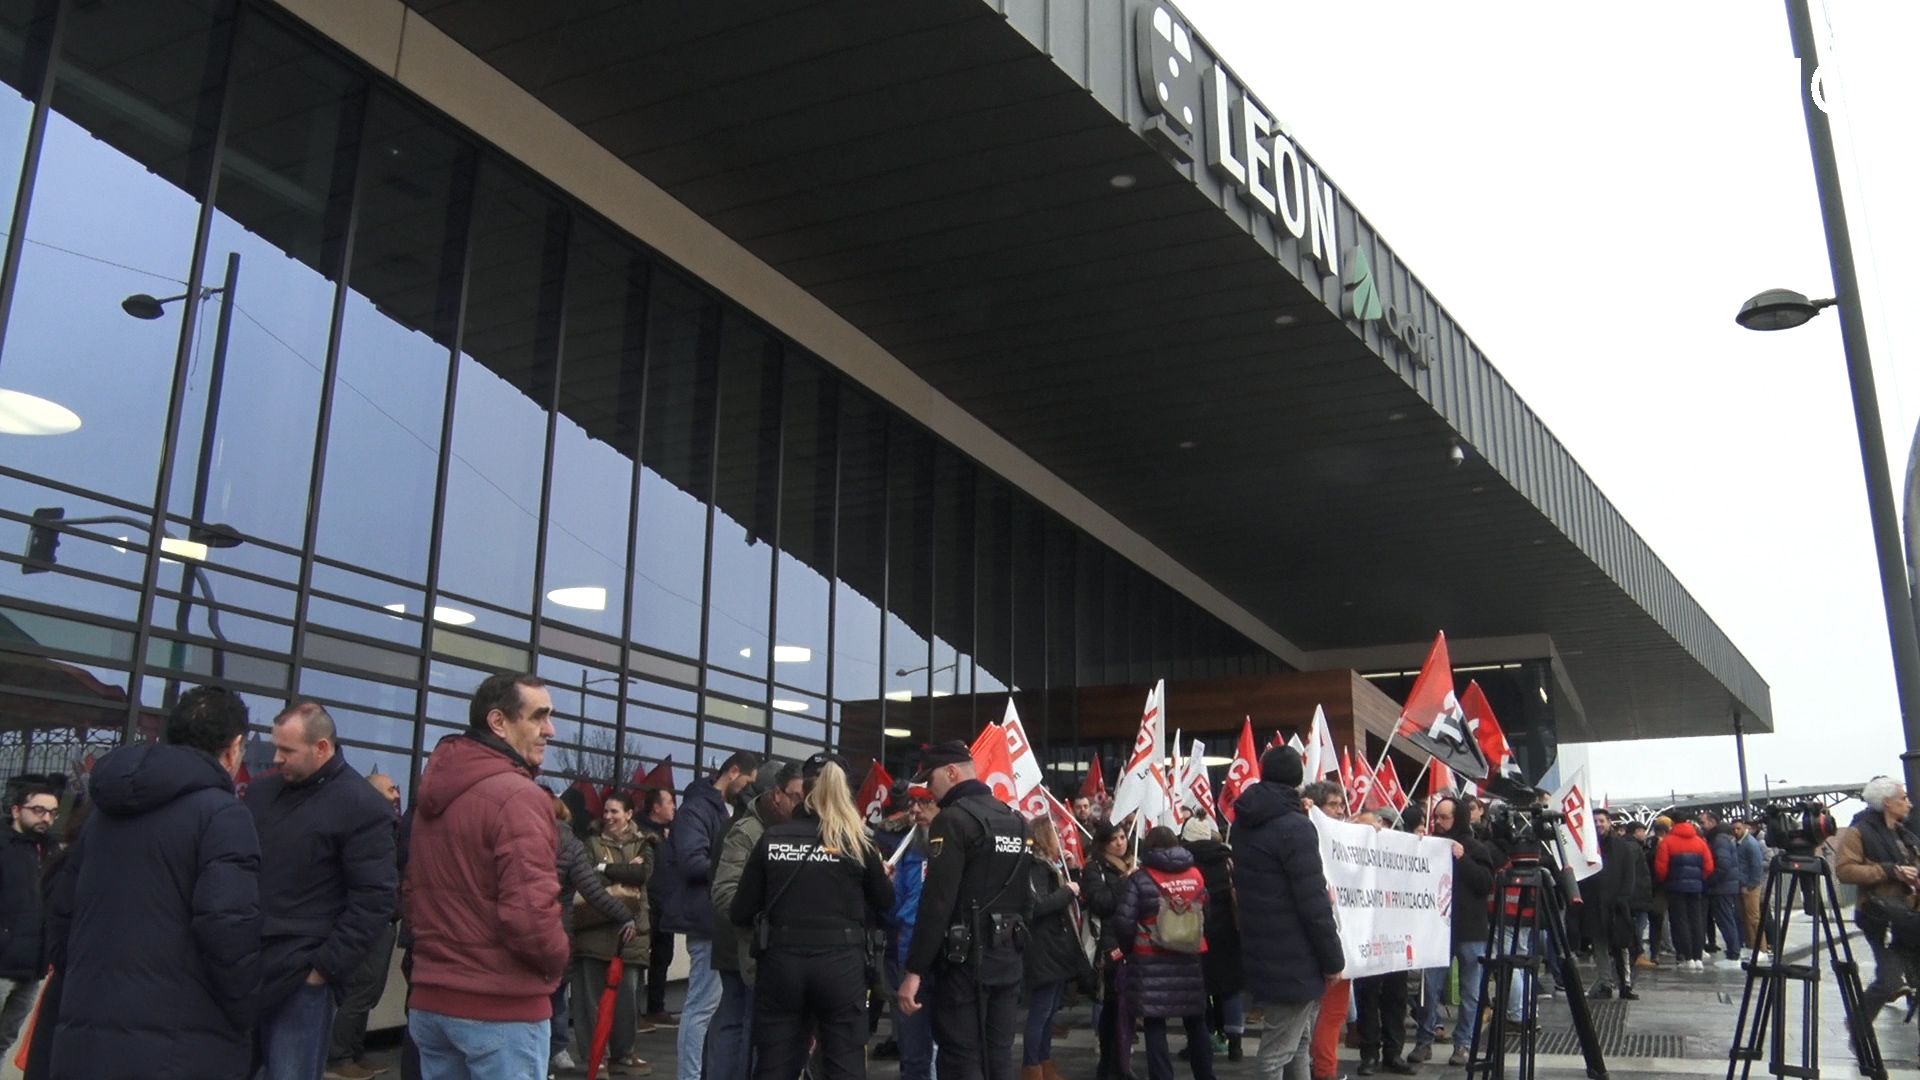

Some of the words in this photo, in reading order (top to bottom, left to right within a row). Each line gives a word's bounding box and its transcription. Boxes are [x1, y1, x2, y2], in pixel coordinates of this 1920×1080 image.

[1205, 64, 1338, 277] LEÓN
[995, 844, 1033, 854] NACIOAL
[1408, 855, 1431, 873] SOCIAL
